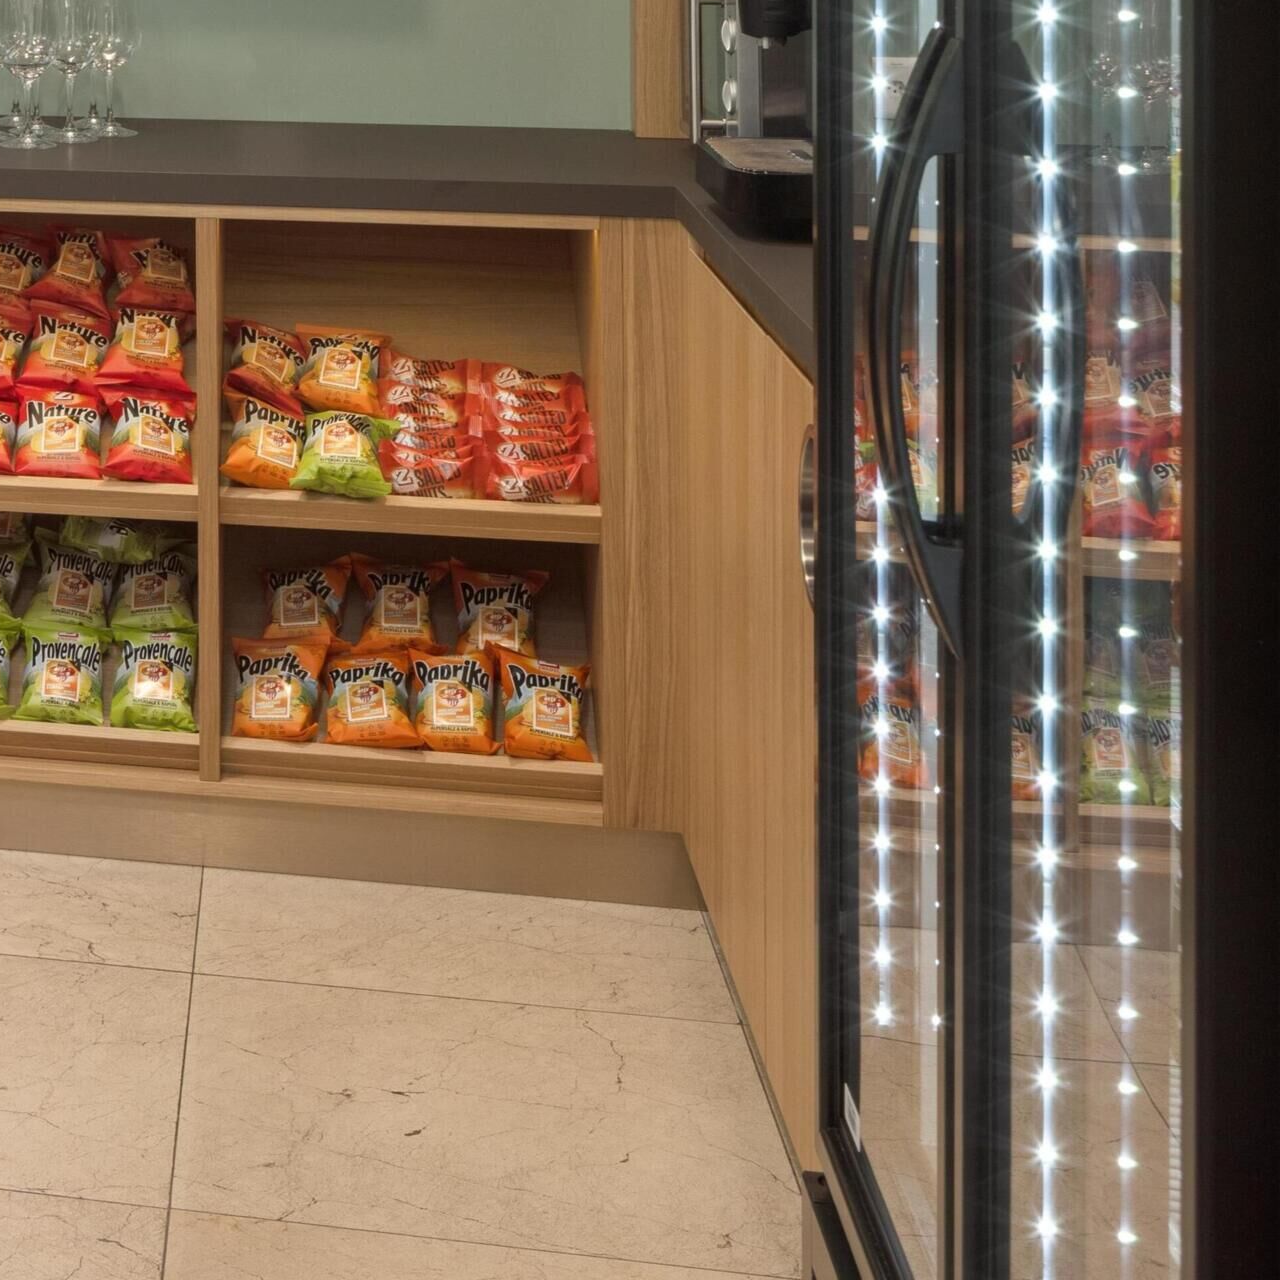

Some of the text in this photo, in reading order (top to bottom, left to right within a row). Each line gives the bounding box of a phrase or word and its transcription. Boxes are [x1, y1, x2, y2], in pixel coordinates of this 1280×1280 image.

[27, 401, 97, 428] Nature
[122, 397, 188, 433] Nature
[520, 436, 568, 461] SALTED
[523, 469, 567, 496] SALTED
[269, 569, 332, 599] Paprika
[461, 582, 535, 613] Paprika
[32, 636, 101, 672] Provençale
[123, 640, 192, 672] Provençale
[238, 652, 308, 683] Paprika
[330, 661, 406, 685] Paprika
[414, 660, 490, 692] Paprika
[508, 664, 583, 702] Paprika
